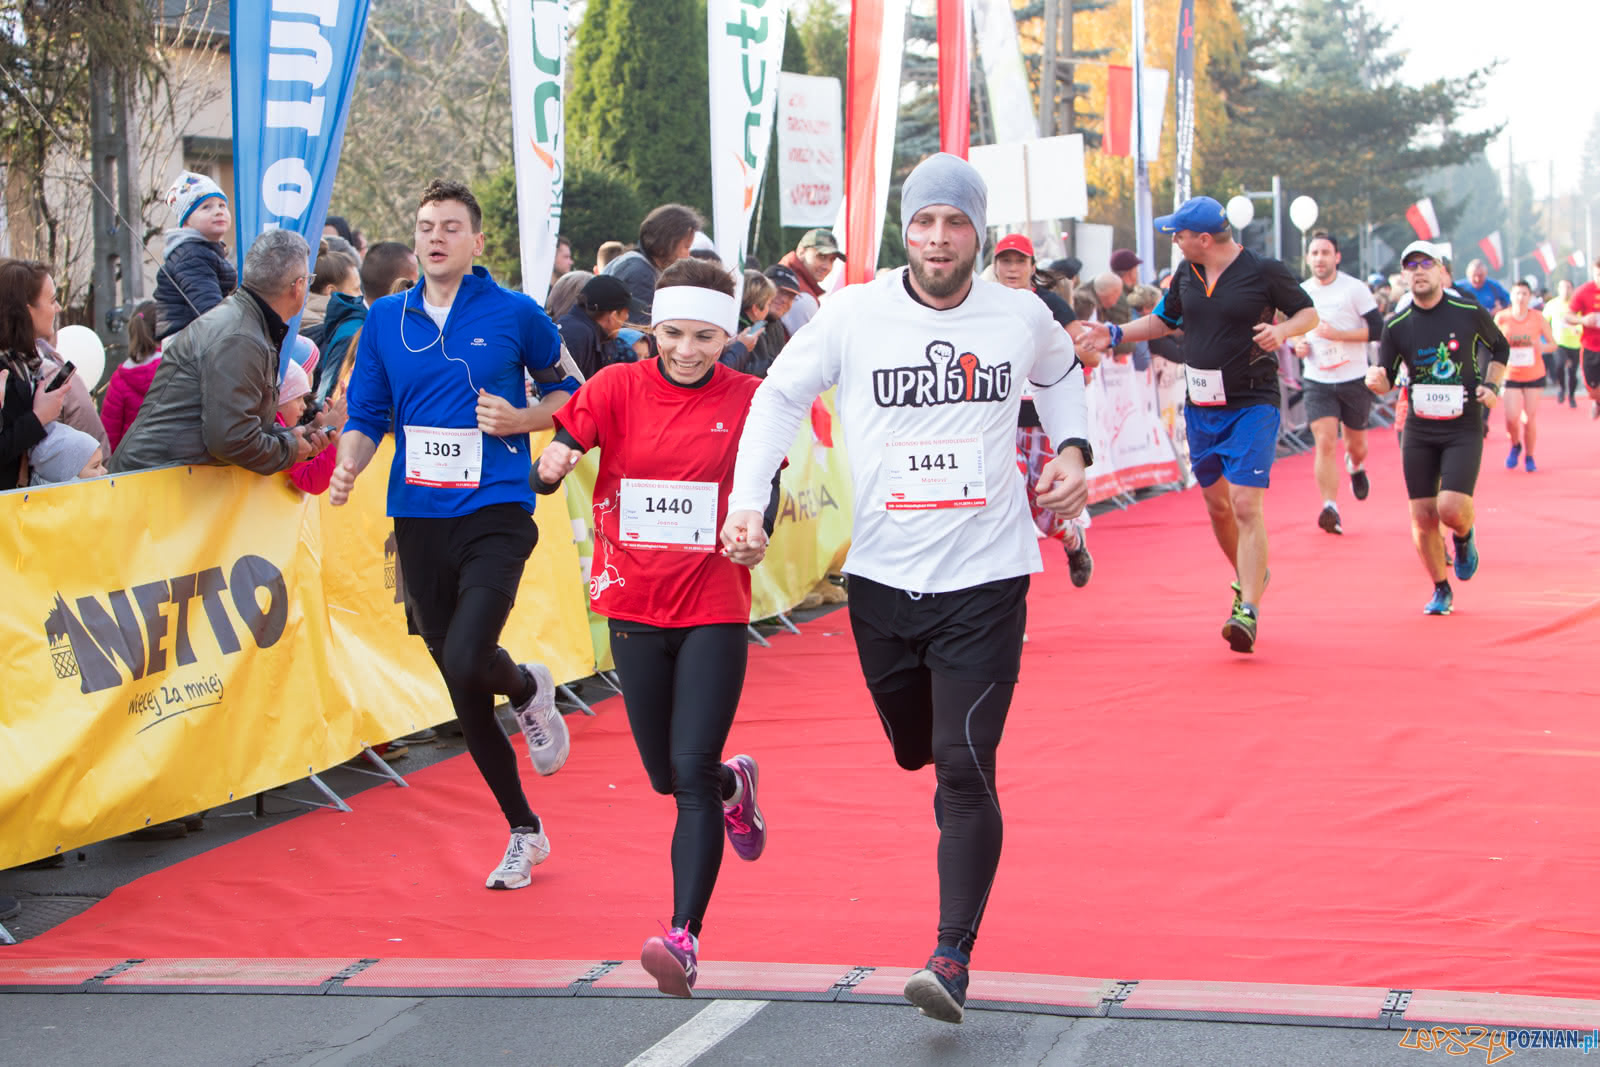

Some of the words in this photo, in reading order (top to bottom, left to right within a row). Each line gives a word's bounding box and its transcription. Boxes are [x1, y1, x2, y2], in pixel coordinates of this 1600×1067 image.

[873, 340, 1011, 407] UPRISING
[1425, 392, 1451, 402] 1095
[425, 441, 461, 457] 1303
[908, 453, 959, 472] 1441
[645, 496, 693, 515] 1440
[778, 484, 839, 525] ARA
[56, 553, 289, 695] NETTO
[183, 673, 224, 700] mniej
